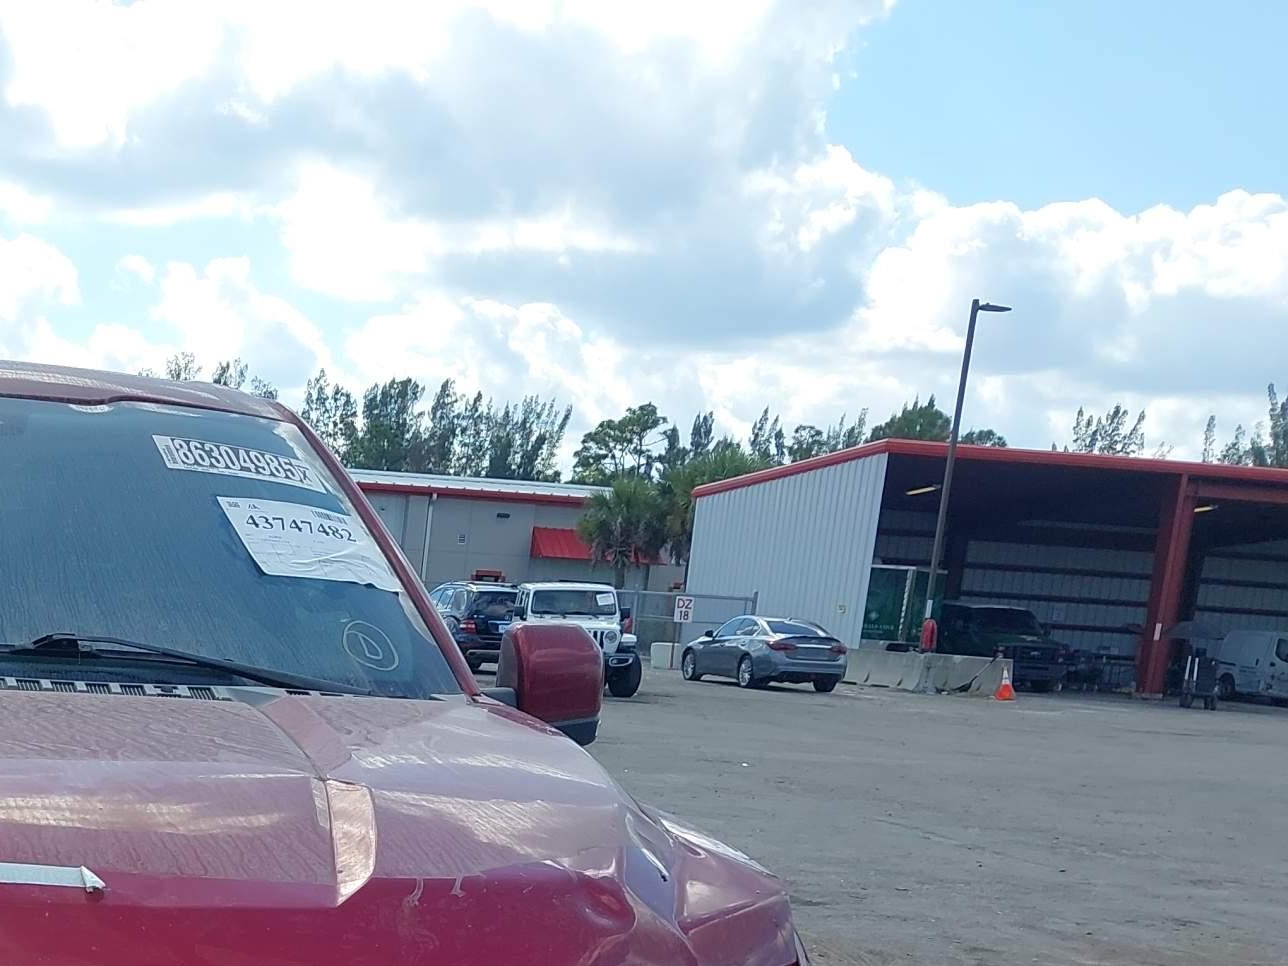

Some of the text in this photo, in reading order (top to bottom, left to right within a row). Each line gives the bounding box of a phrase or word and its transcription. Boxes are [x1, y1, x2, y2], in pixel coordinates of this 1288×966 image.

[172, 438, 302, 482] 86304985
[246, 514, 357, 543] 43747482
[677, 598, 693, 609] DZ
[678, 610, 689, 621] 18
